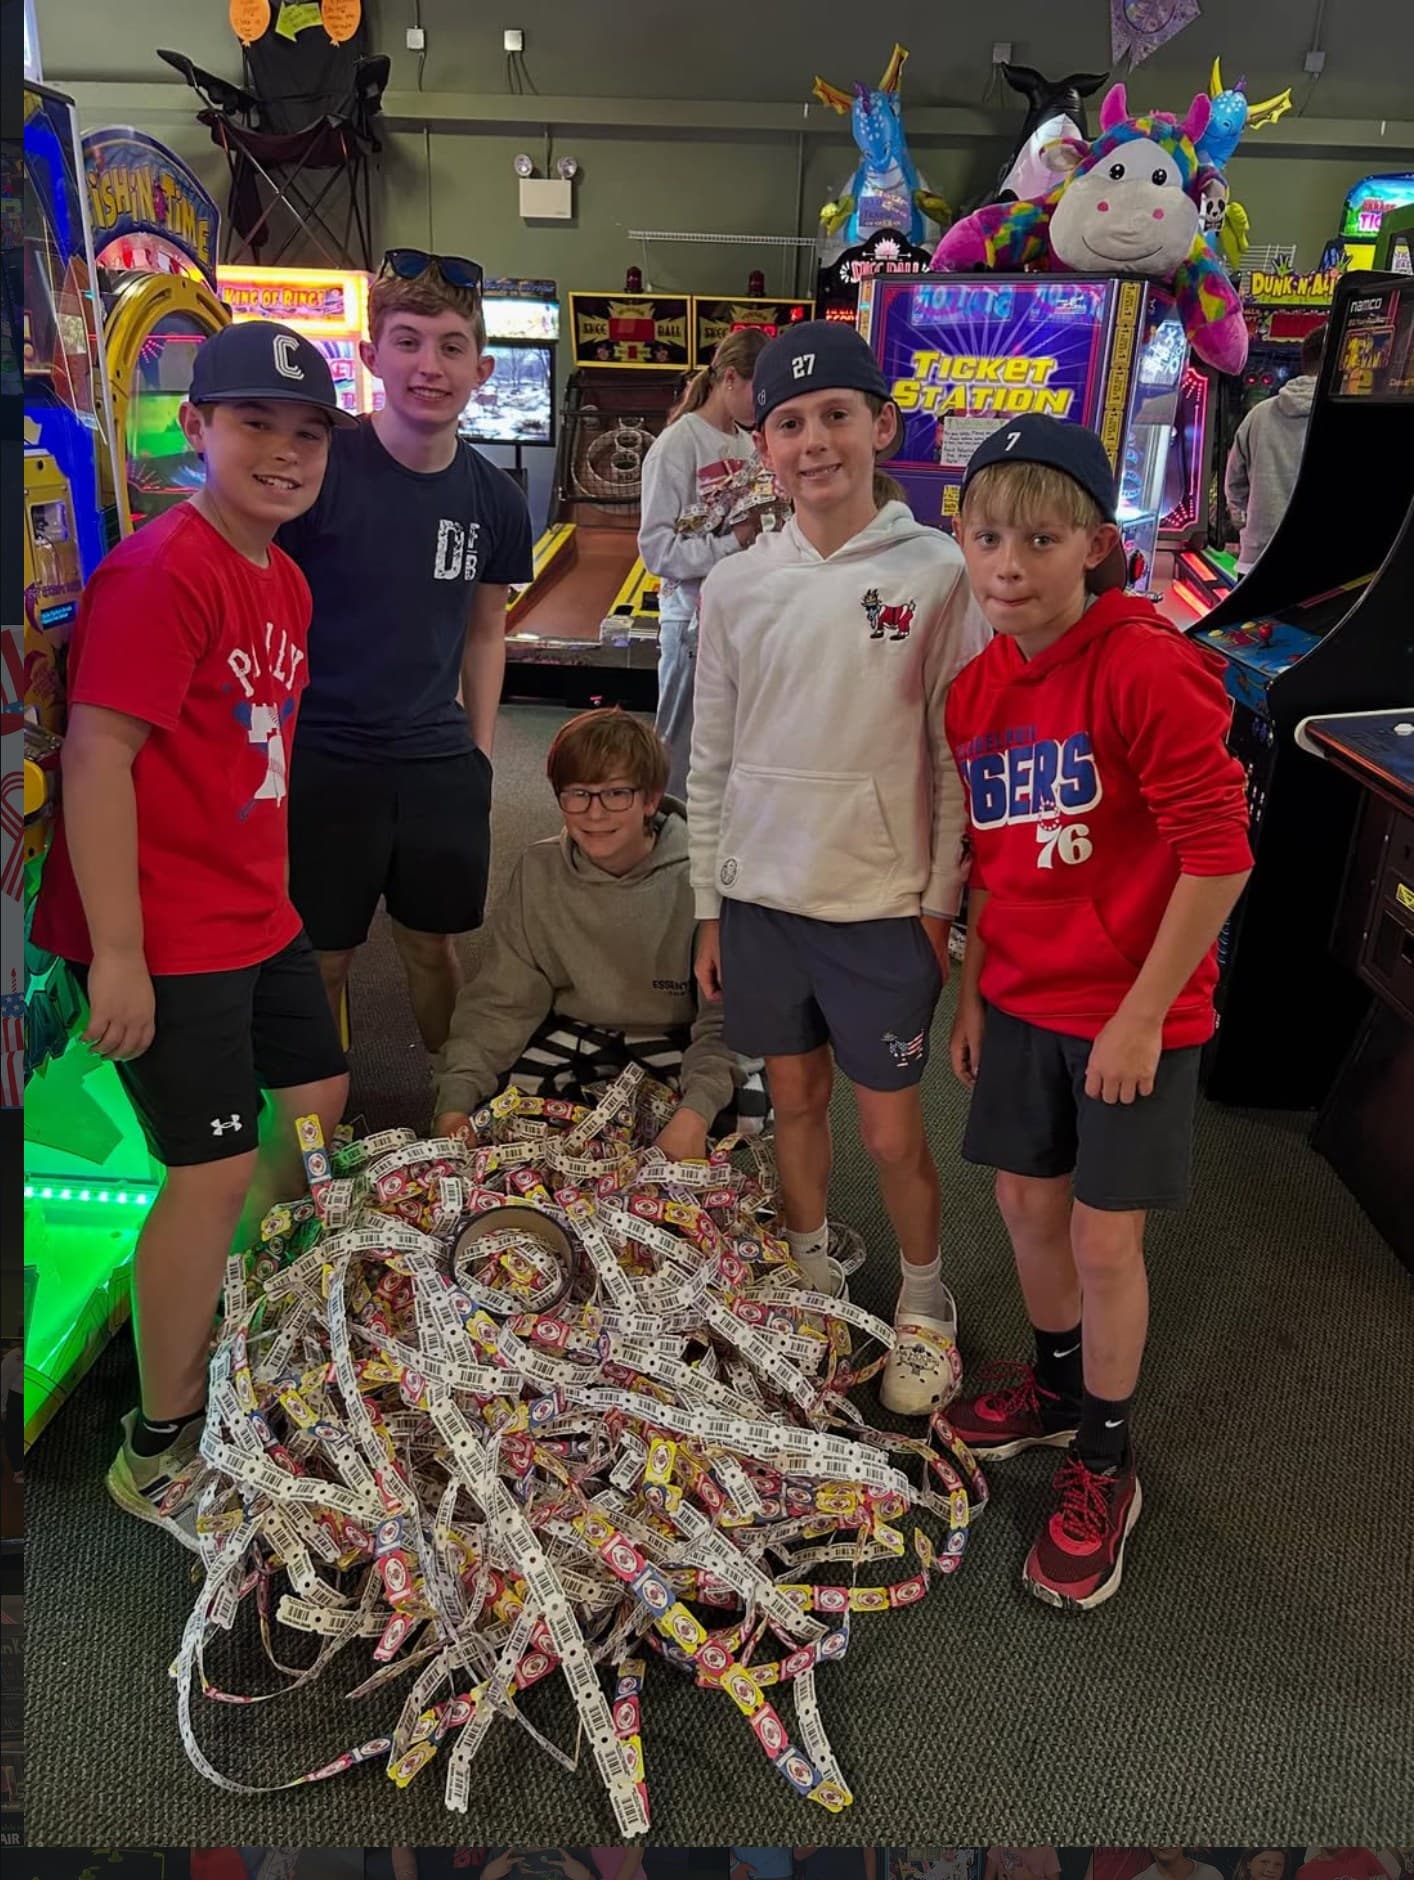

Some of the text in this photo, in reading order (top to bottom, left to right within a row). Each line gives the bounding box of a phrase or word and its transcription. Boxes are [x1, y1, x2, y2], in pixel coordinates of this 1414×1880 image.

[1251, 271, 1294, 296] DUNK
[224, 287, 325, 308] KING OF RINGS
[1350, 298, 1383, 312] namco
[273, 334, 305, 380] C
[792, 353, 815, 380] 27
[912, 350, 1057, 384] TICKET
[891, 379, 1074, 416] STATION
[1005, 431, 1021, 452] 7
[1035, 823, 1093, 870] 76
